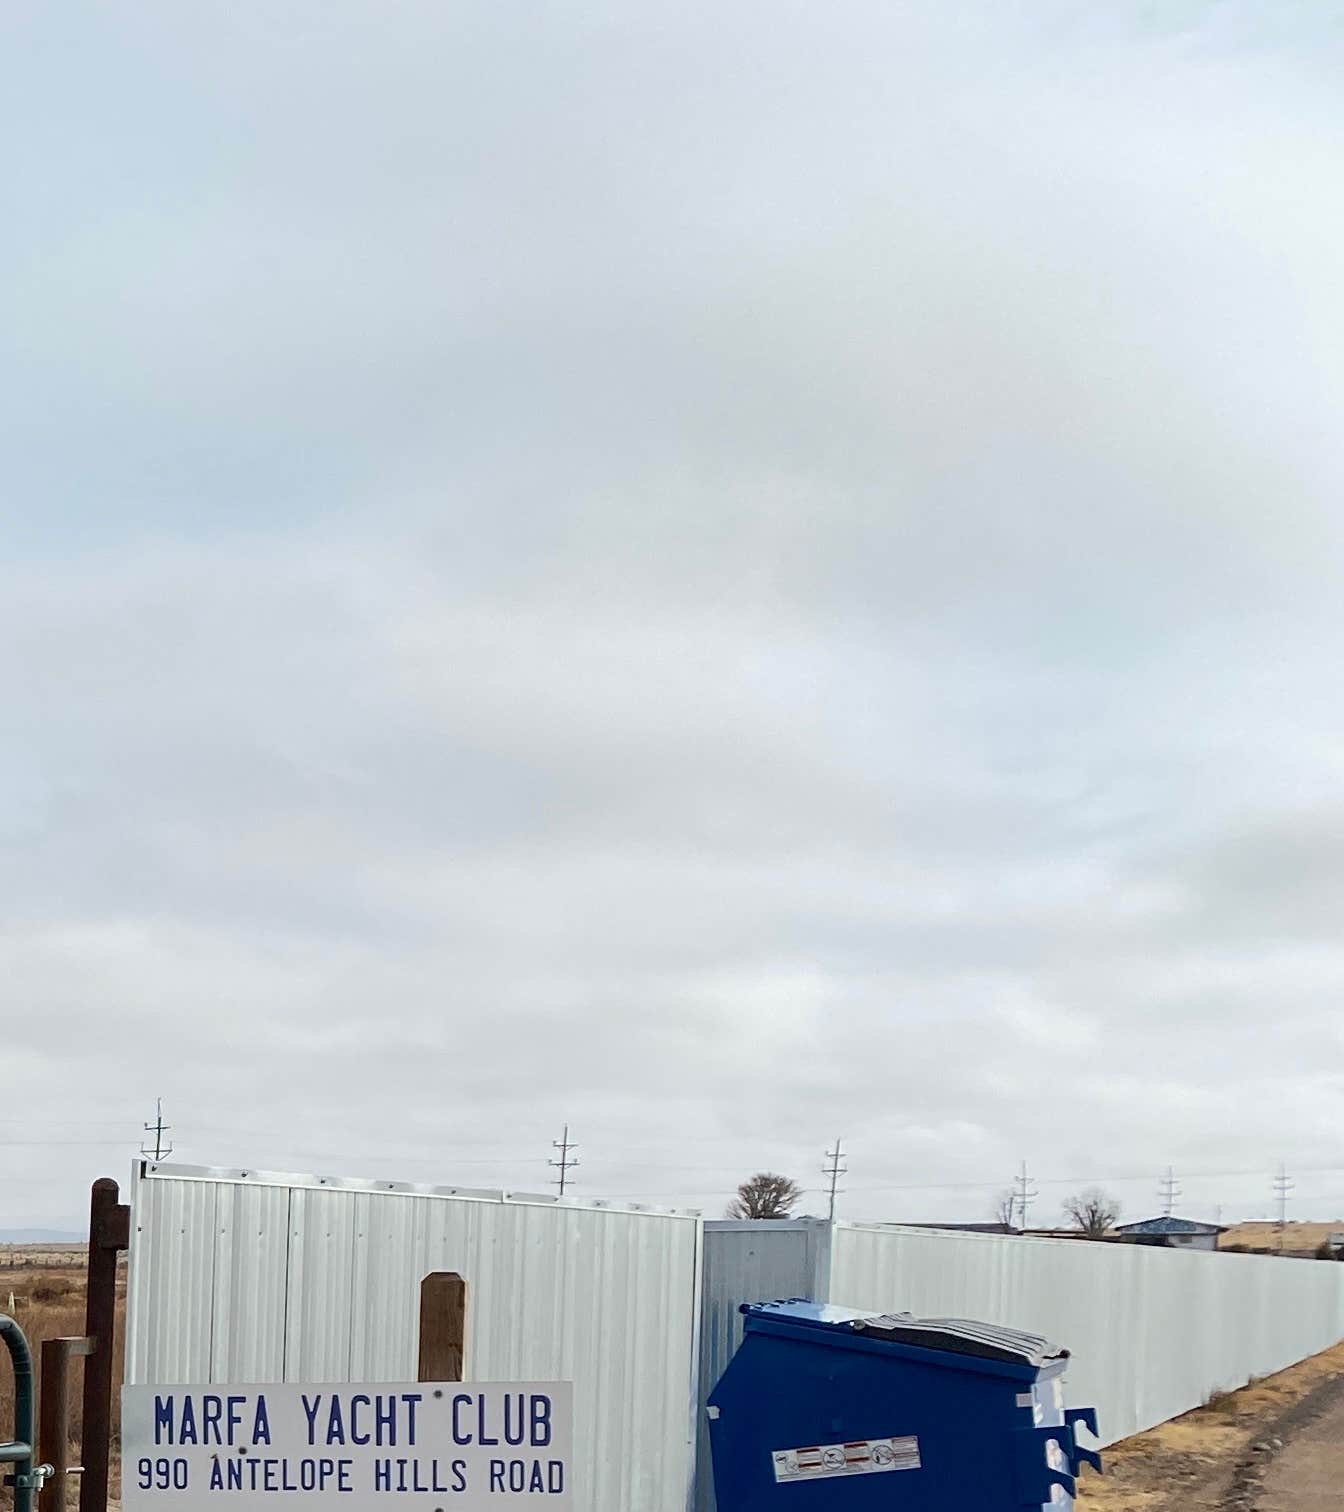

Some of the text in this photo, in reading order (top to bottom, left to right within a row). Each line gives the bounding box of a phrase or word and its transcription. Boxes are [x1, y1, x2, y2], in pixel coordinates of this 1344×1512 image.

[155, 1394, 551, 1446] MARFA YACHT CLUB
[139, 1458, 563, 1493] 990 ANTELOPE HILLS ROAD
